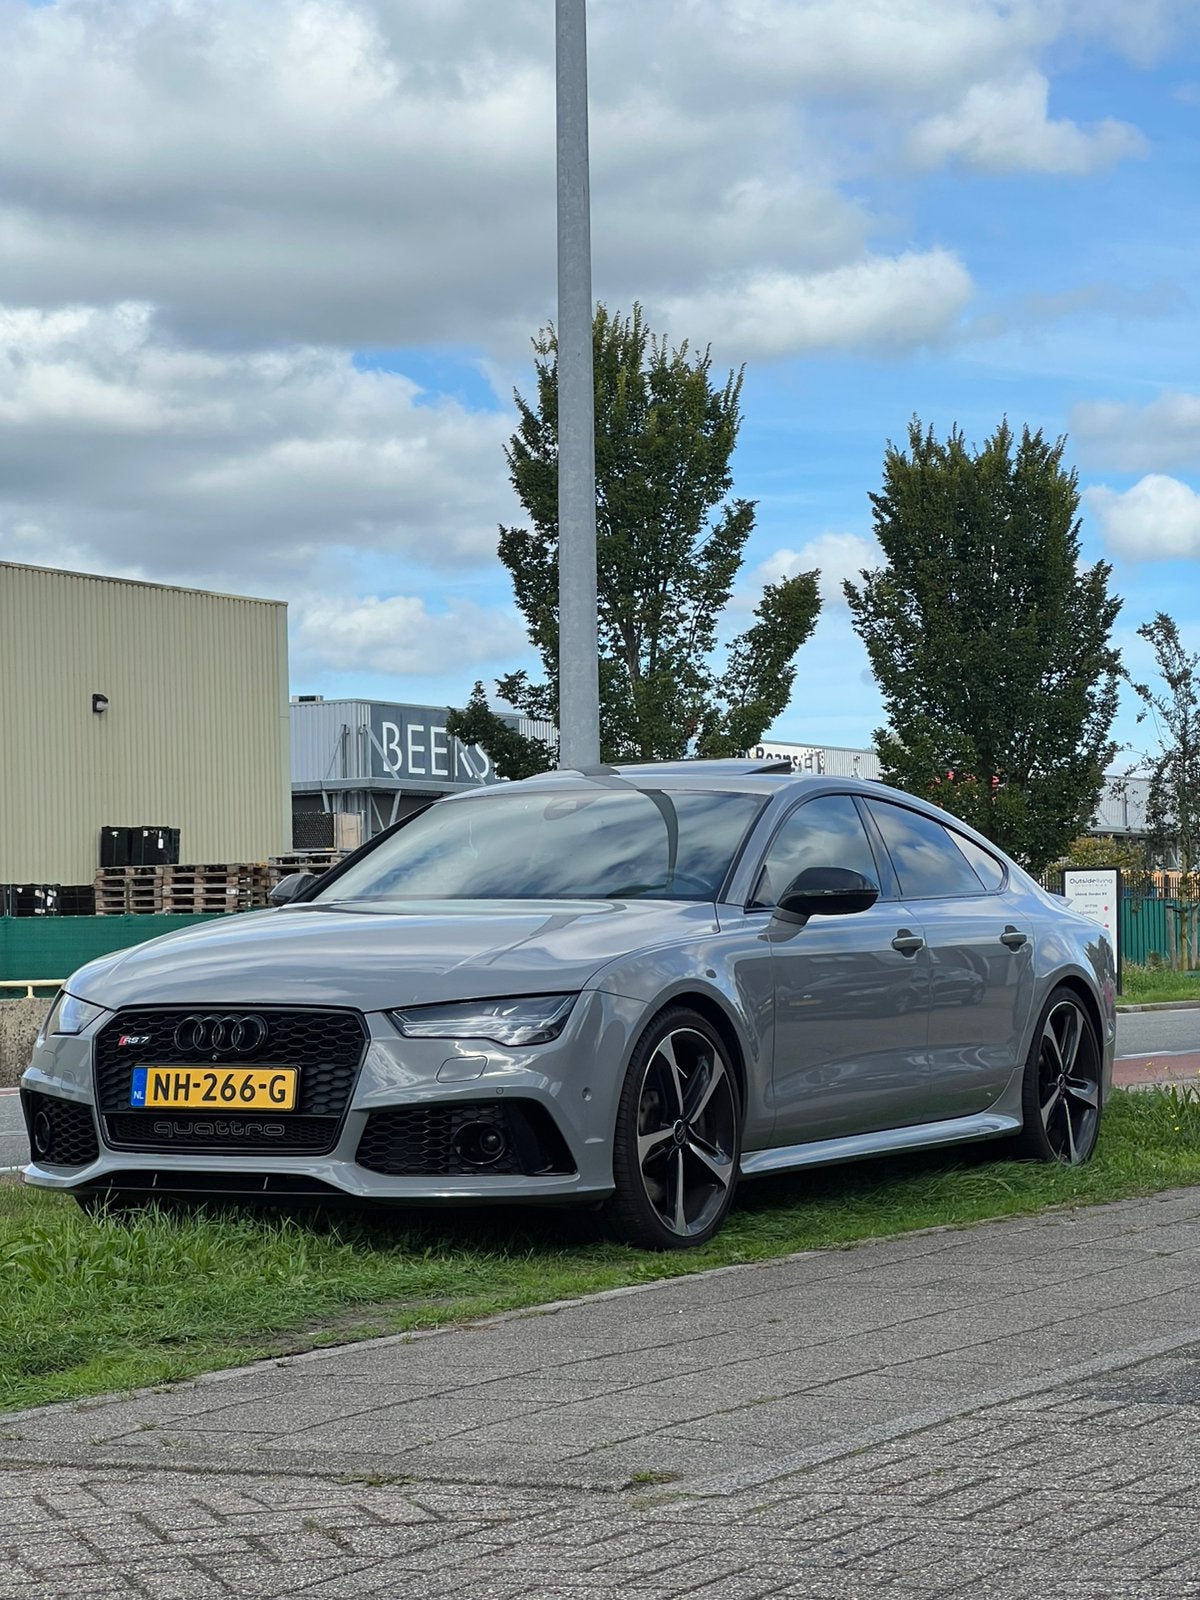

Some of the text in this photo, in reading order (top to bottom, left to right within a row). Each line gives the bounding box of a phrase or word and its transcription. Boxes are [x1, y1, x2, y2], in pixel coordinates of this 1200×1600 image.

[133, 1073, 286, 1103] NL NH-266-G
[153, 1120, 285, 1138] quattro
